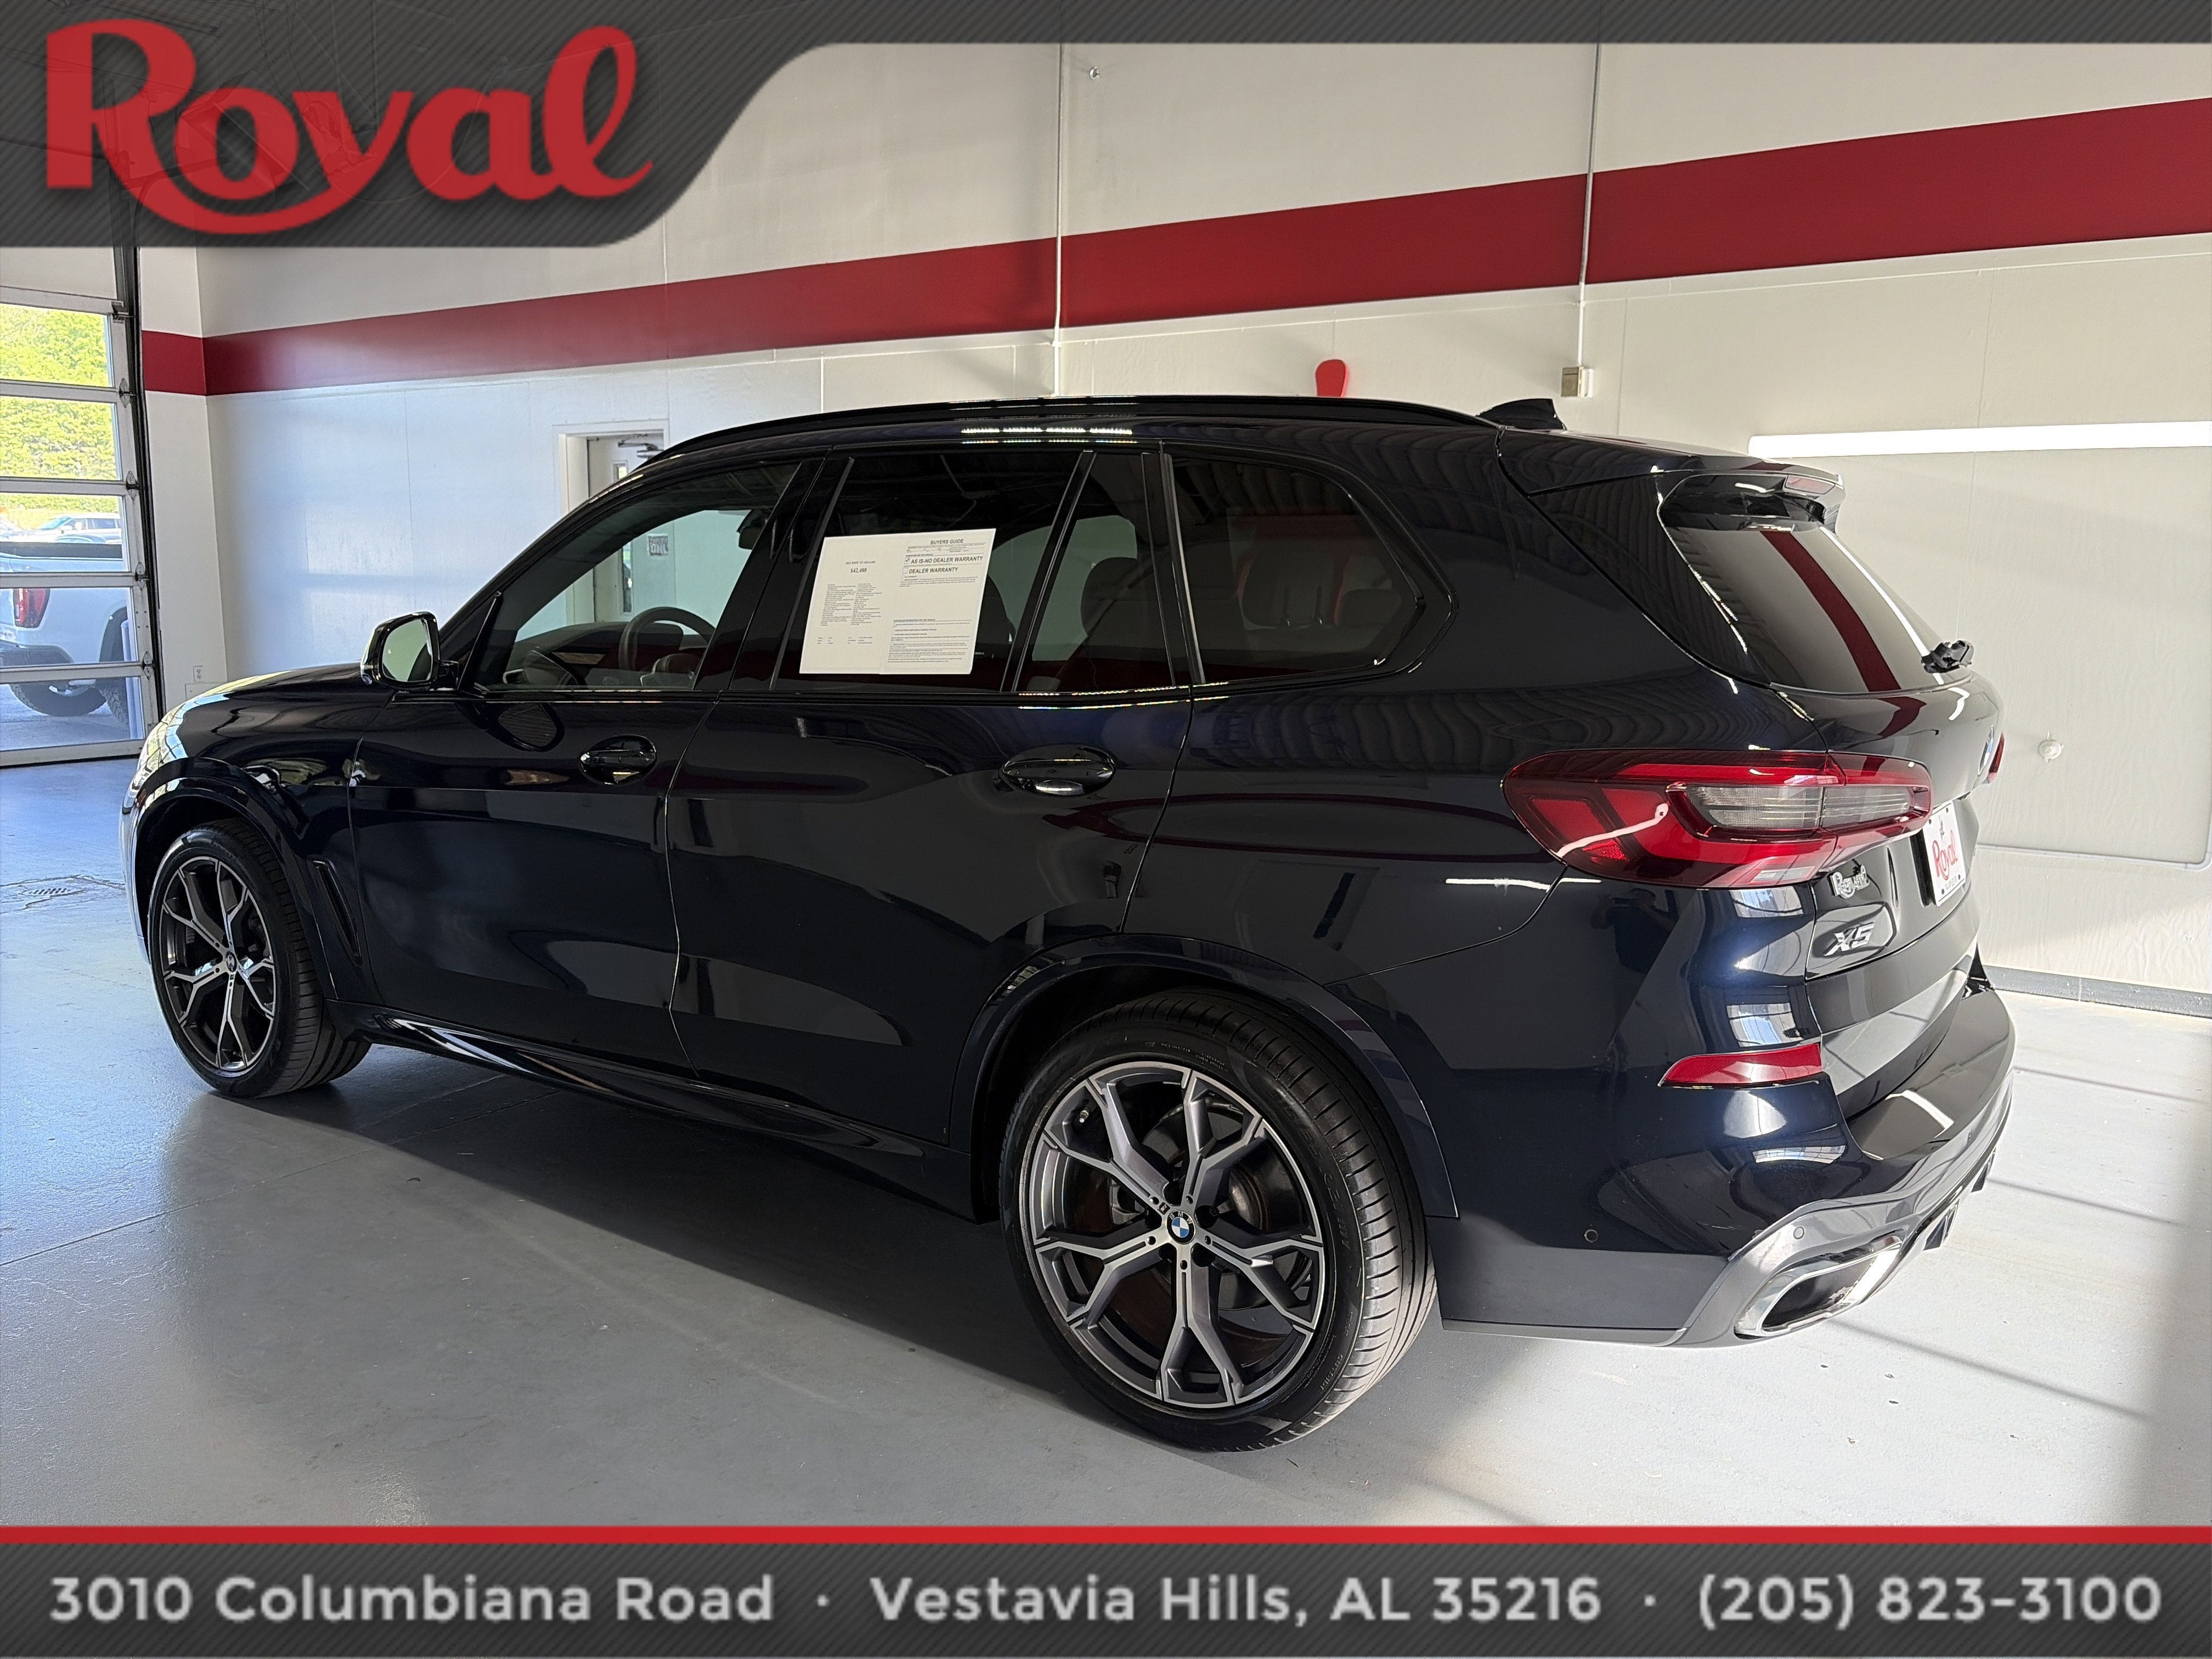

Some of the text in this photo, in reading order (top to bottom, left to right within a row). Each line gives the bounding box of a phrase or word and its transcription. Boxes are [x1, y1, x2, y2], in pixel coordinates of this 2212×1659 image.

[1829, 865, 1870, 899] Royal
[1824, 923, 1875, 957] X5
[1169, 1211, 1193, 1224] BMW
